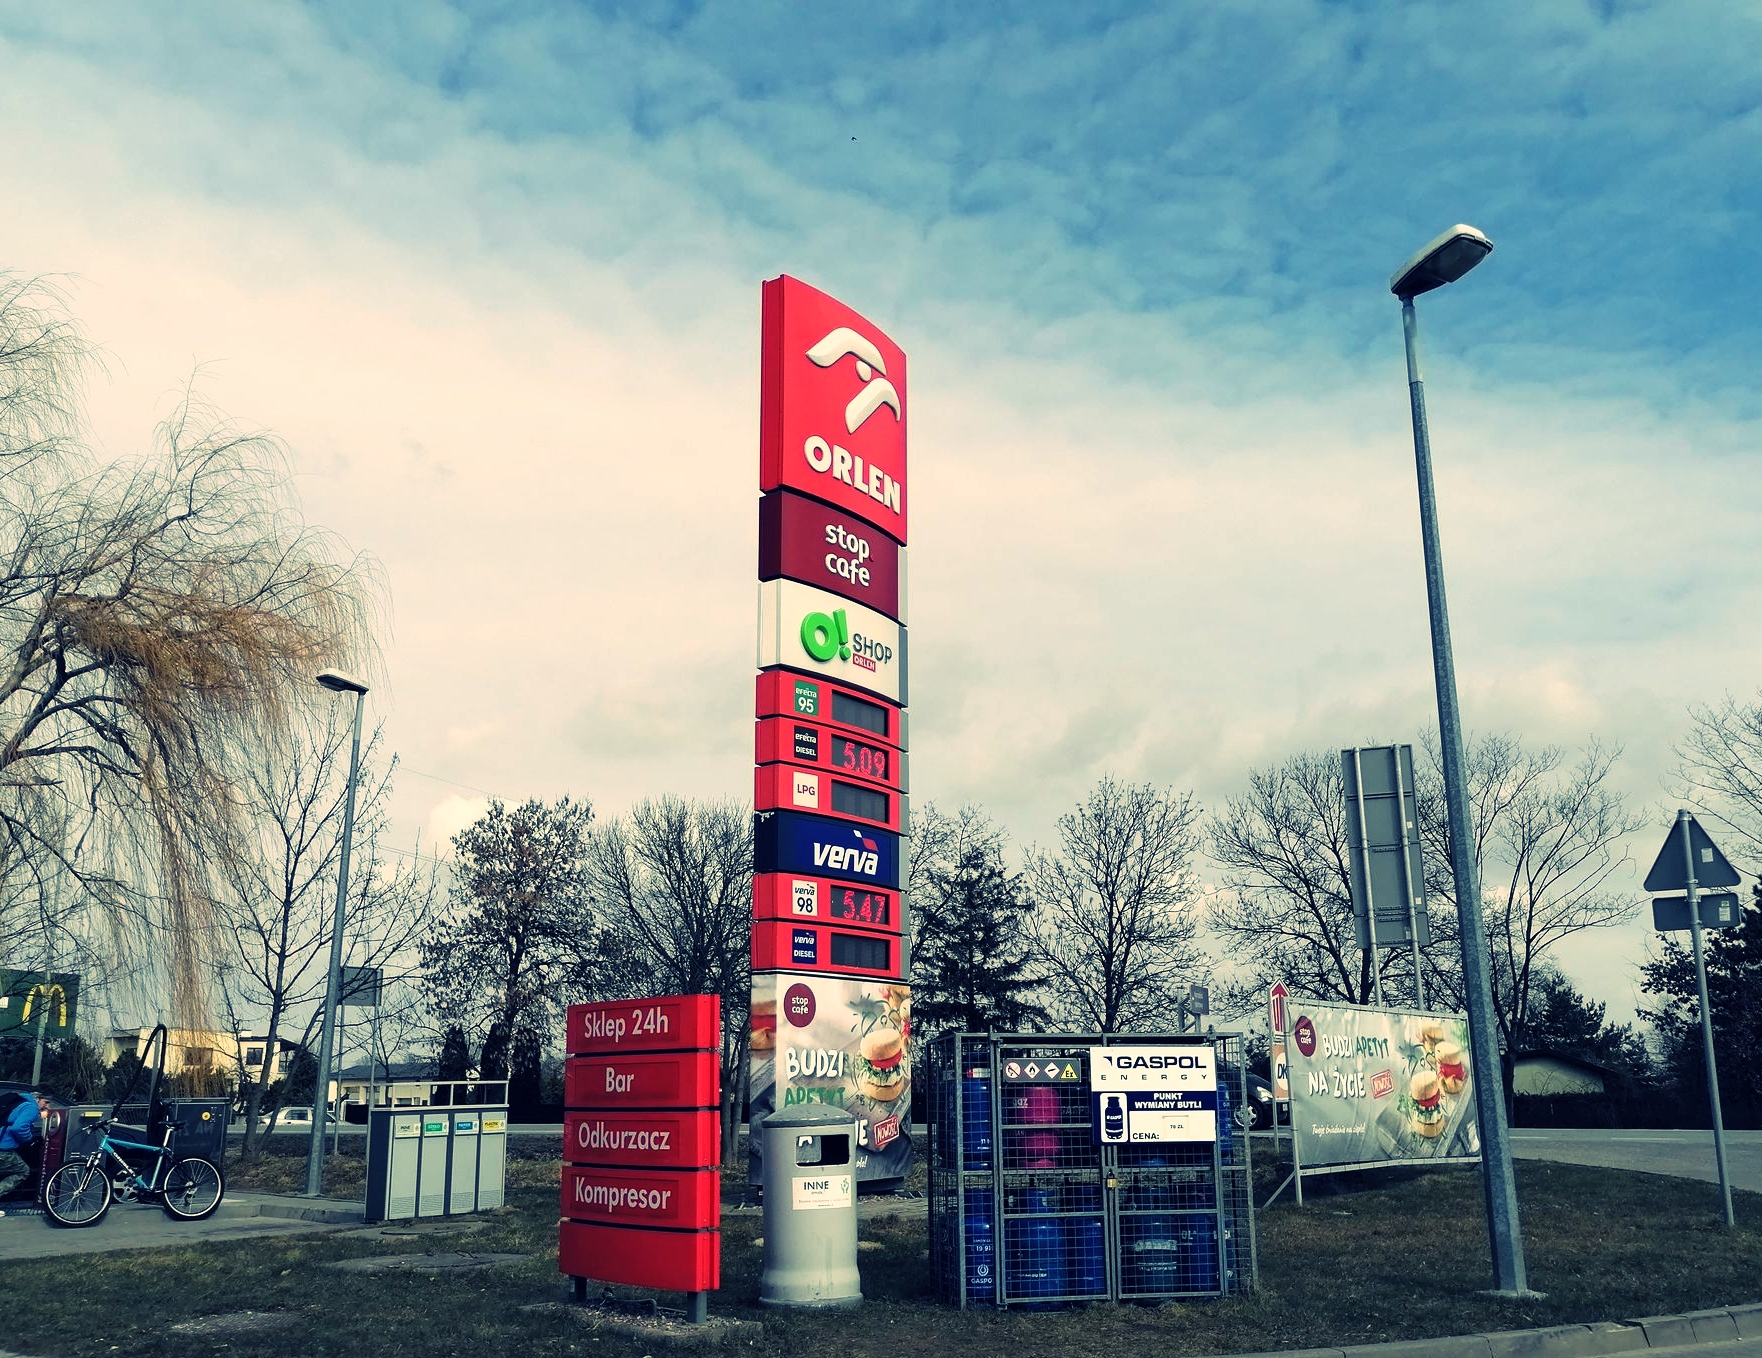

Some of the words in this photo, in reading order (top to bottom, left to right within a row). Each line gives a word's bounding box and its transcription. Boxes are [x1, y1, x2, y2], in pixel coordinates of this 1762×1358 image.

[804, 435, 901, 515] ORLEN
[825, 524, 870, 563] stop
[825, 553, 870, 587] cafe
[853, 633, 893, 664] SHOP
[854, 655, 876, 671] ORLEN
[798, 697, 814, 713] 95
[795, 745, 817, 756] DIESEL
[844, 741, 885, 778] 5.09
[797, 784, 816, 796] LPG
[813, 842, 879, 876] verva
[794, 886, 815, 896] verva
[797, 897, 813, 913] 98
[843, 890, 886, 923] 5.47
[794, 935, 815, 944] verva
[794, 949, 816, 959] DIESEL
[791, 995, 809, 1007] stop
[791, 1004, 809, 1015] cafe
[584, 1010, 626, 1042] Sklep
[632, 1006, 669, 1035] 24h
[1322, 1034, 1354, 1059] BUDZI
[1356, 1036, 1389, 1059] APETYT
[785, 1047, 844, 1080] BUDZI
[1116, 1056, 1207, 1069] GASPOL
[605, 1067, 634, 1092] Bar
[1065, 1070, 1074, 1078] Ex
[1277, 1063, 1288, 1080] DK
[1308, 1071, 1329, 1096] NA
[1333, 1066, 1366, 1099] ŻYCIE
[1153, 1092, 1183, 1100] PUNKT
[1134, 1101, 1176, 1109] WYMIANY
[1177, 1101, 1202, 1109] BUTLI
[578, 1121, 670, 1150] Odkurzacz
[803, 1180, 829, 1190] INNE
[575, 1176, 671, 1213] Kompresor
